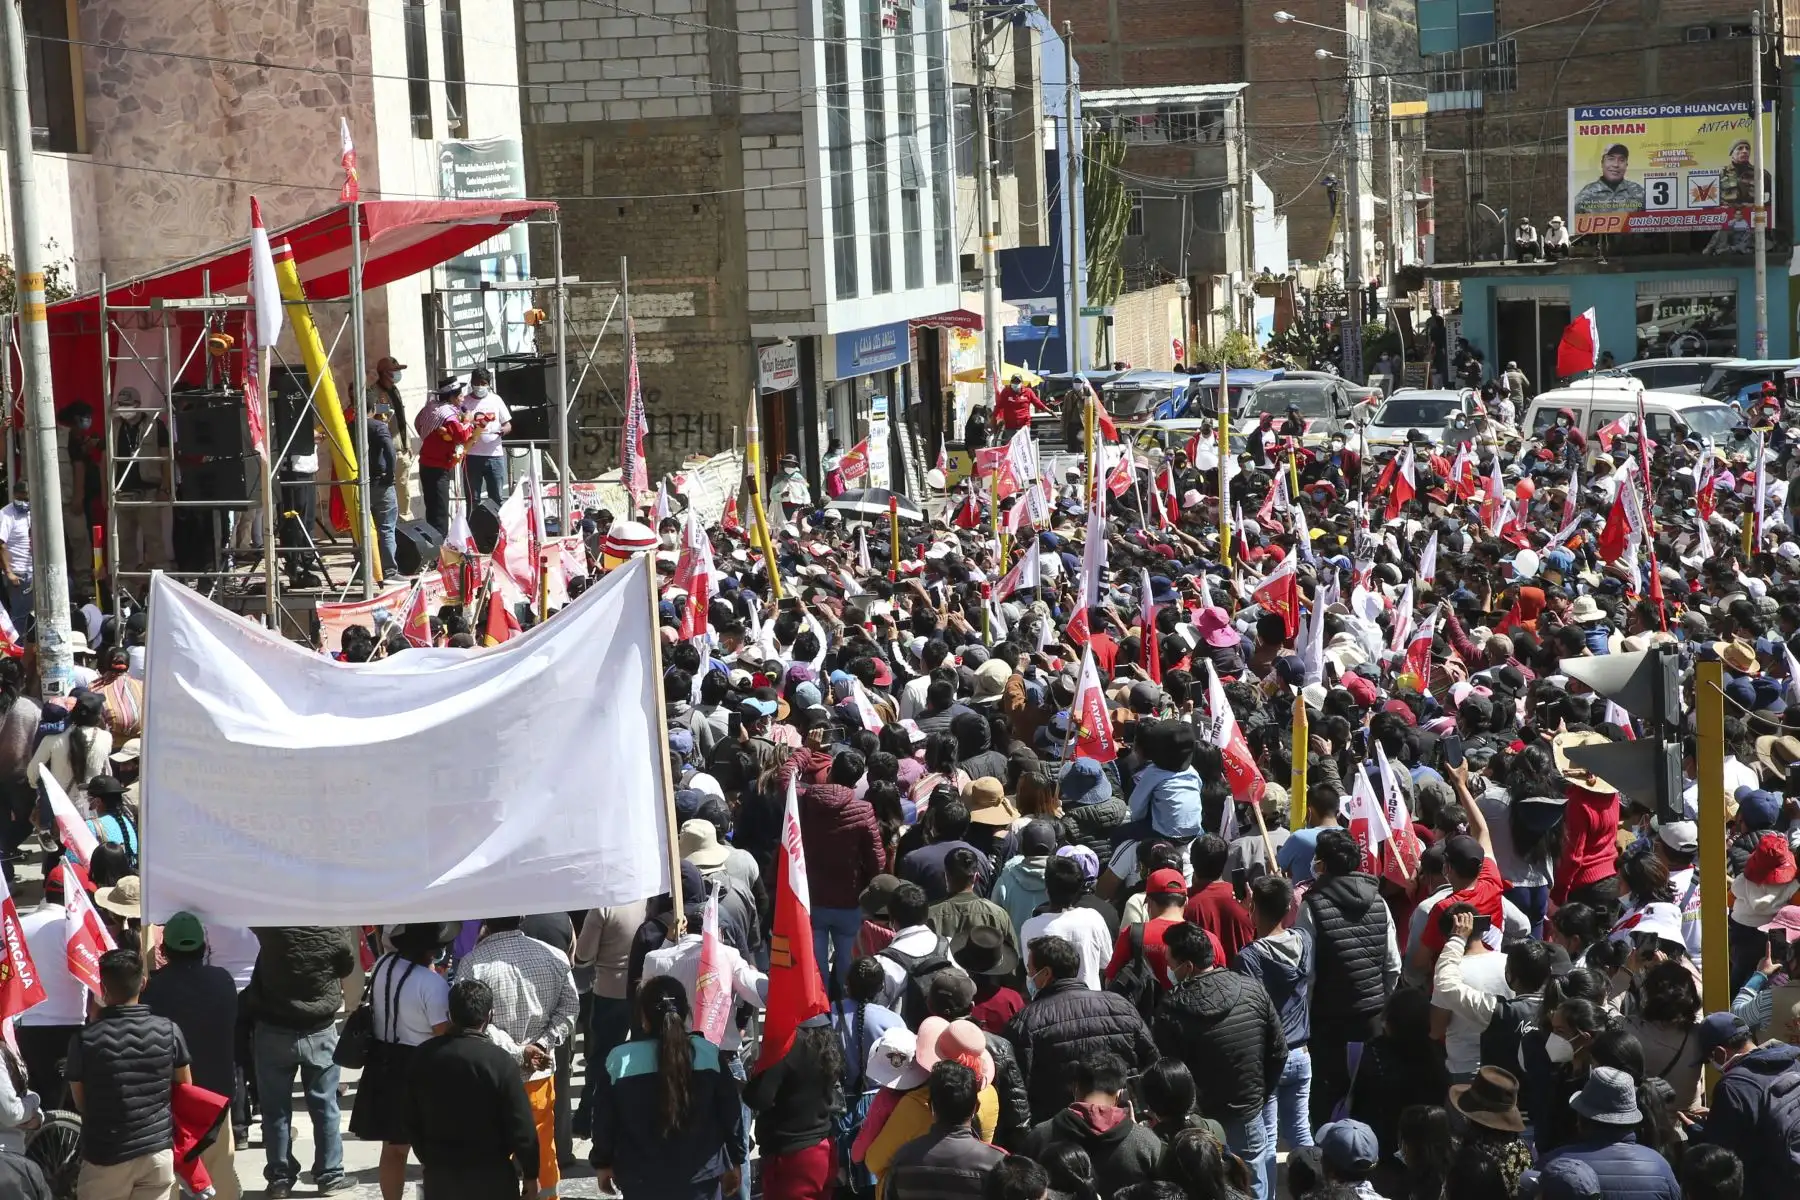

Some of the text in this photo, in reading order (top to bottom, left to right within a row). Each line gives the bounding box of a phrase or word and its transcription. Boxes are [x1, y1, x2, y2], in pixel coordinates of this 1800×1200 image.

[1581, 109, 1595, 118] AL
[1600, 107, 1657, 117] CONGRESO
[1660, 105, 1682, 114] POR
[1579, 123, 1647, 136] NORMAN
[1653, 181, 1669, 206] 3
[1577, 216, 1621, 233] UPP
[1629, 211, 1728, 226] UNIÓN POR EL PERÚ
[1090, 699, 1109, 751] TAYACAJA
[4, 914, 34, 990] TAYACAJA
